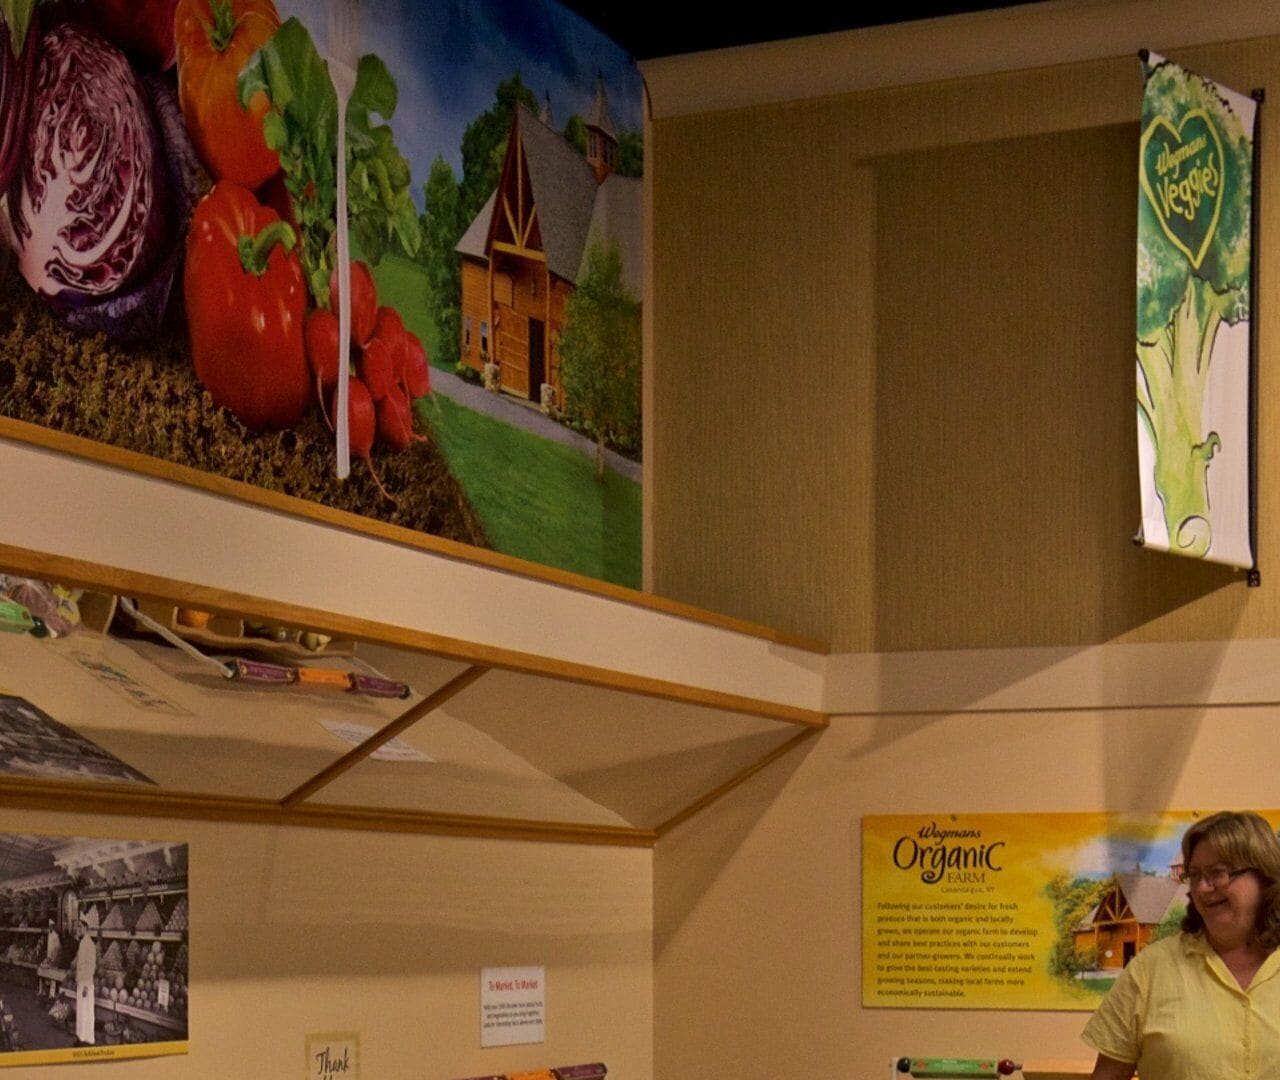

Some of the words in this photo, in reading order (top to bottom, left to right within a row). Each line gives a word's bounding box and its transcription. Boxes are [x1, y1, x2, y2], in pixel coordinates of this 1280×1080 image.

[1156, 152, 1219, 221] Veggies
[918, 821, 982, 846] Wegmans
[947, 872, 986, 884] FARM
[315, 1046, 350, 1075] Thank
